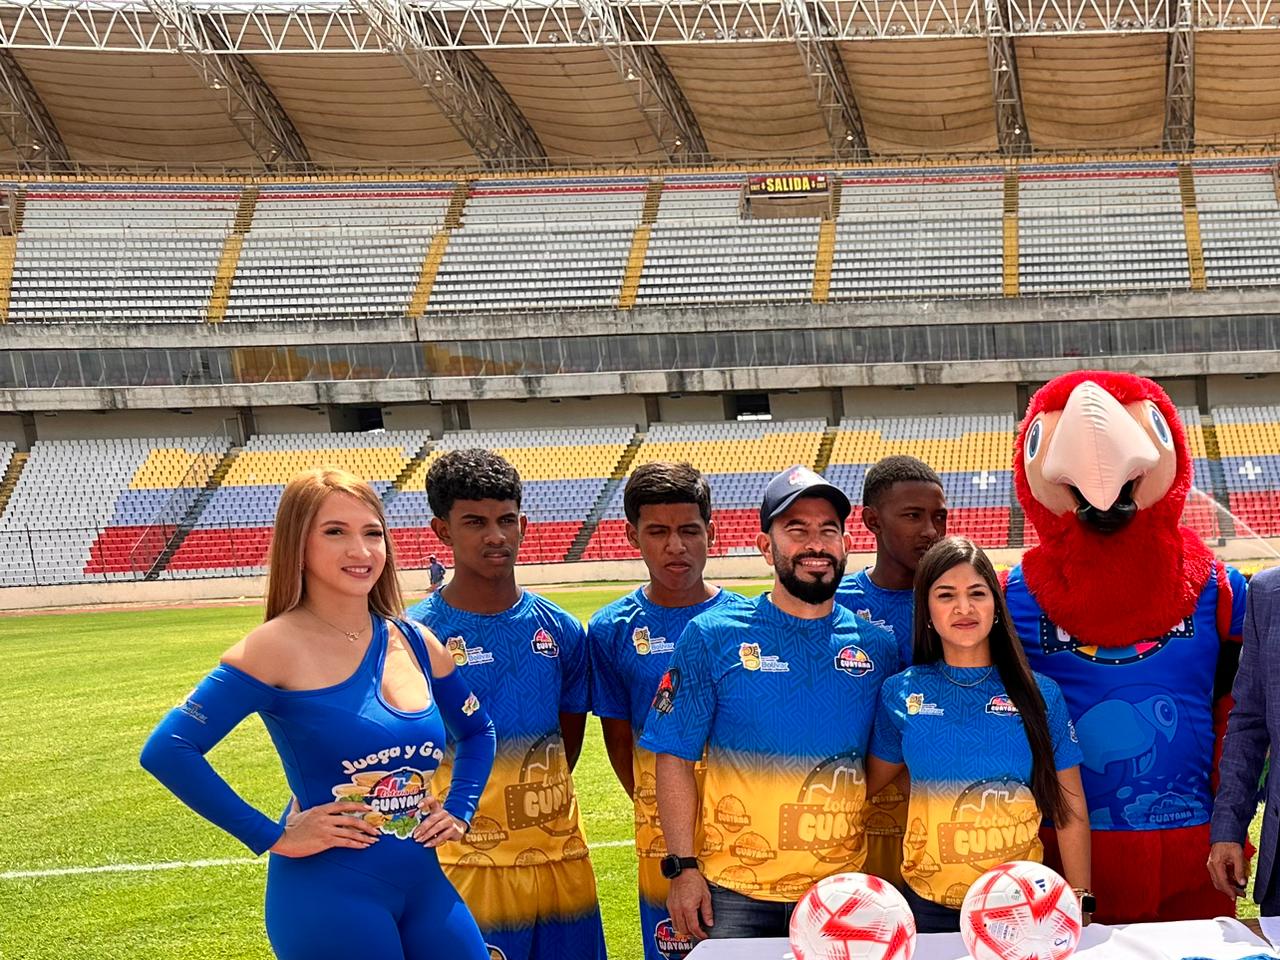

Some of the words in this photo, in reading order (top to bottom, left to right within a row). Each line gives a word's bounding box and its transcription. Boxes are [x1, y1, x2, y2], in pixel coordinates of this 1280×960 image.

[766, 177, 811, 192] SALIDA
[341, 746, 401, 775] Juega
[404, 745, 417, 759] y
[419, 741, 444, 761] Ga
[371, 793, 424, 813] GUAYAN
[1149, 810, 1192, 824] GUAYANA
[953, 818, 1038, 856] GUAYAN
